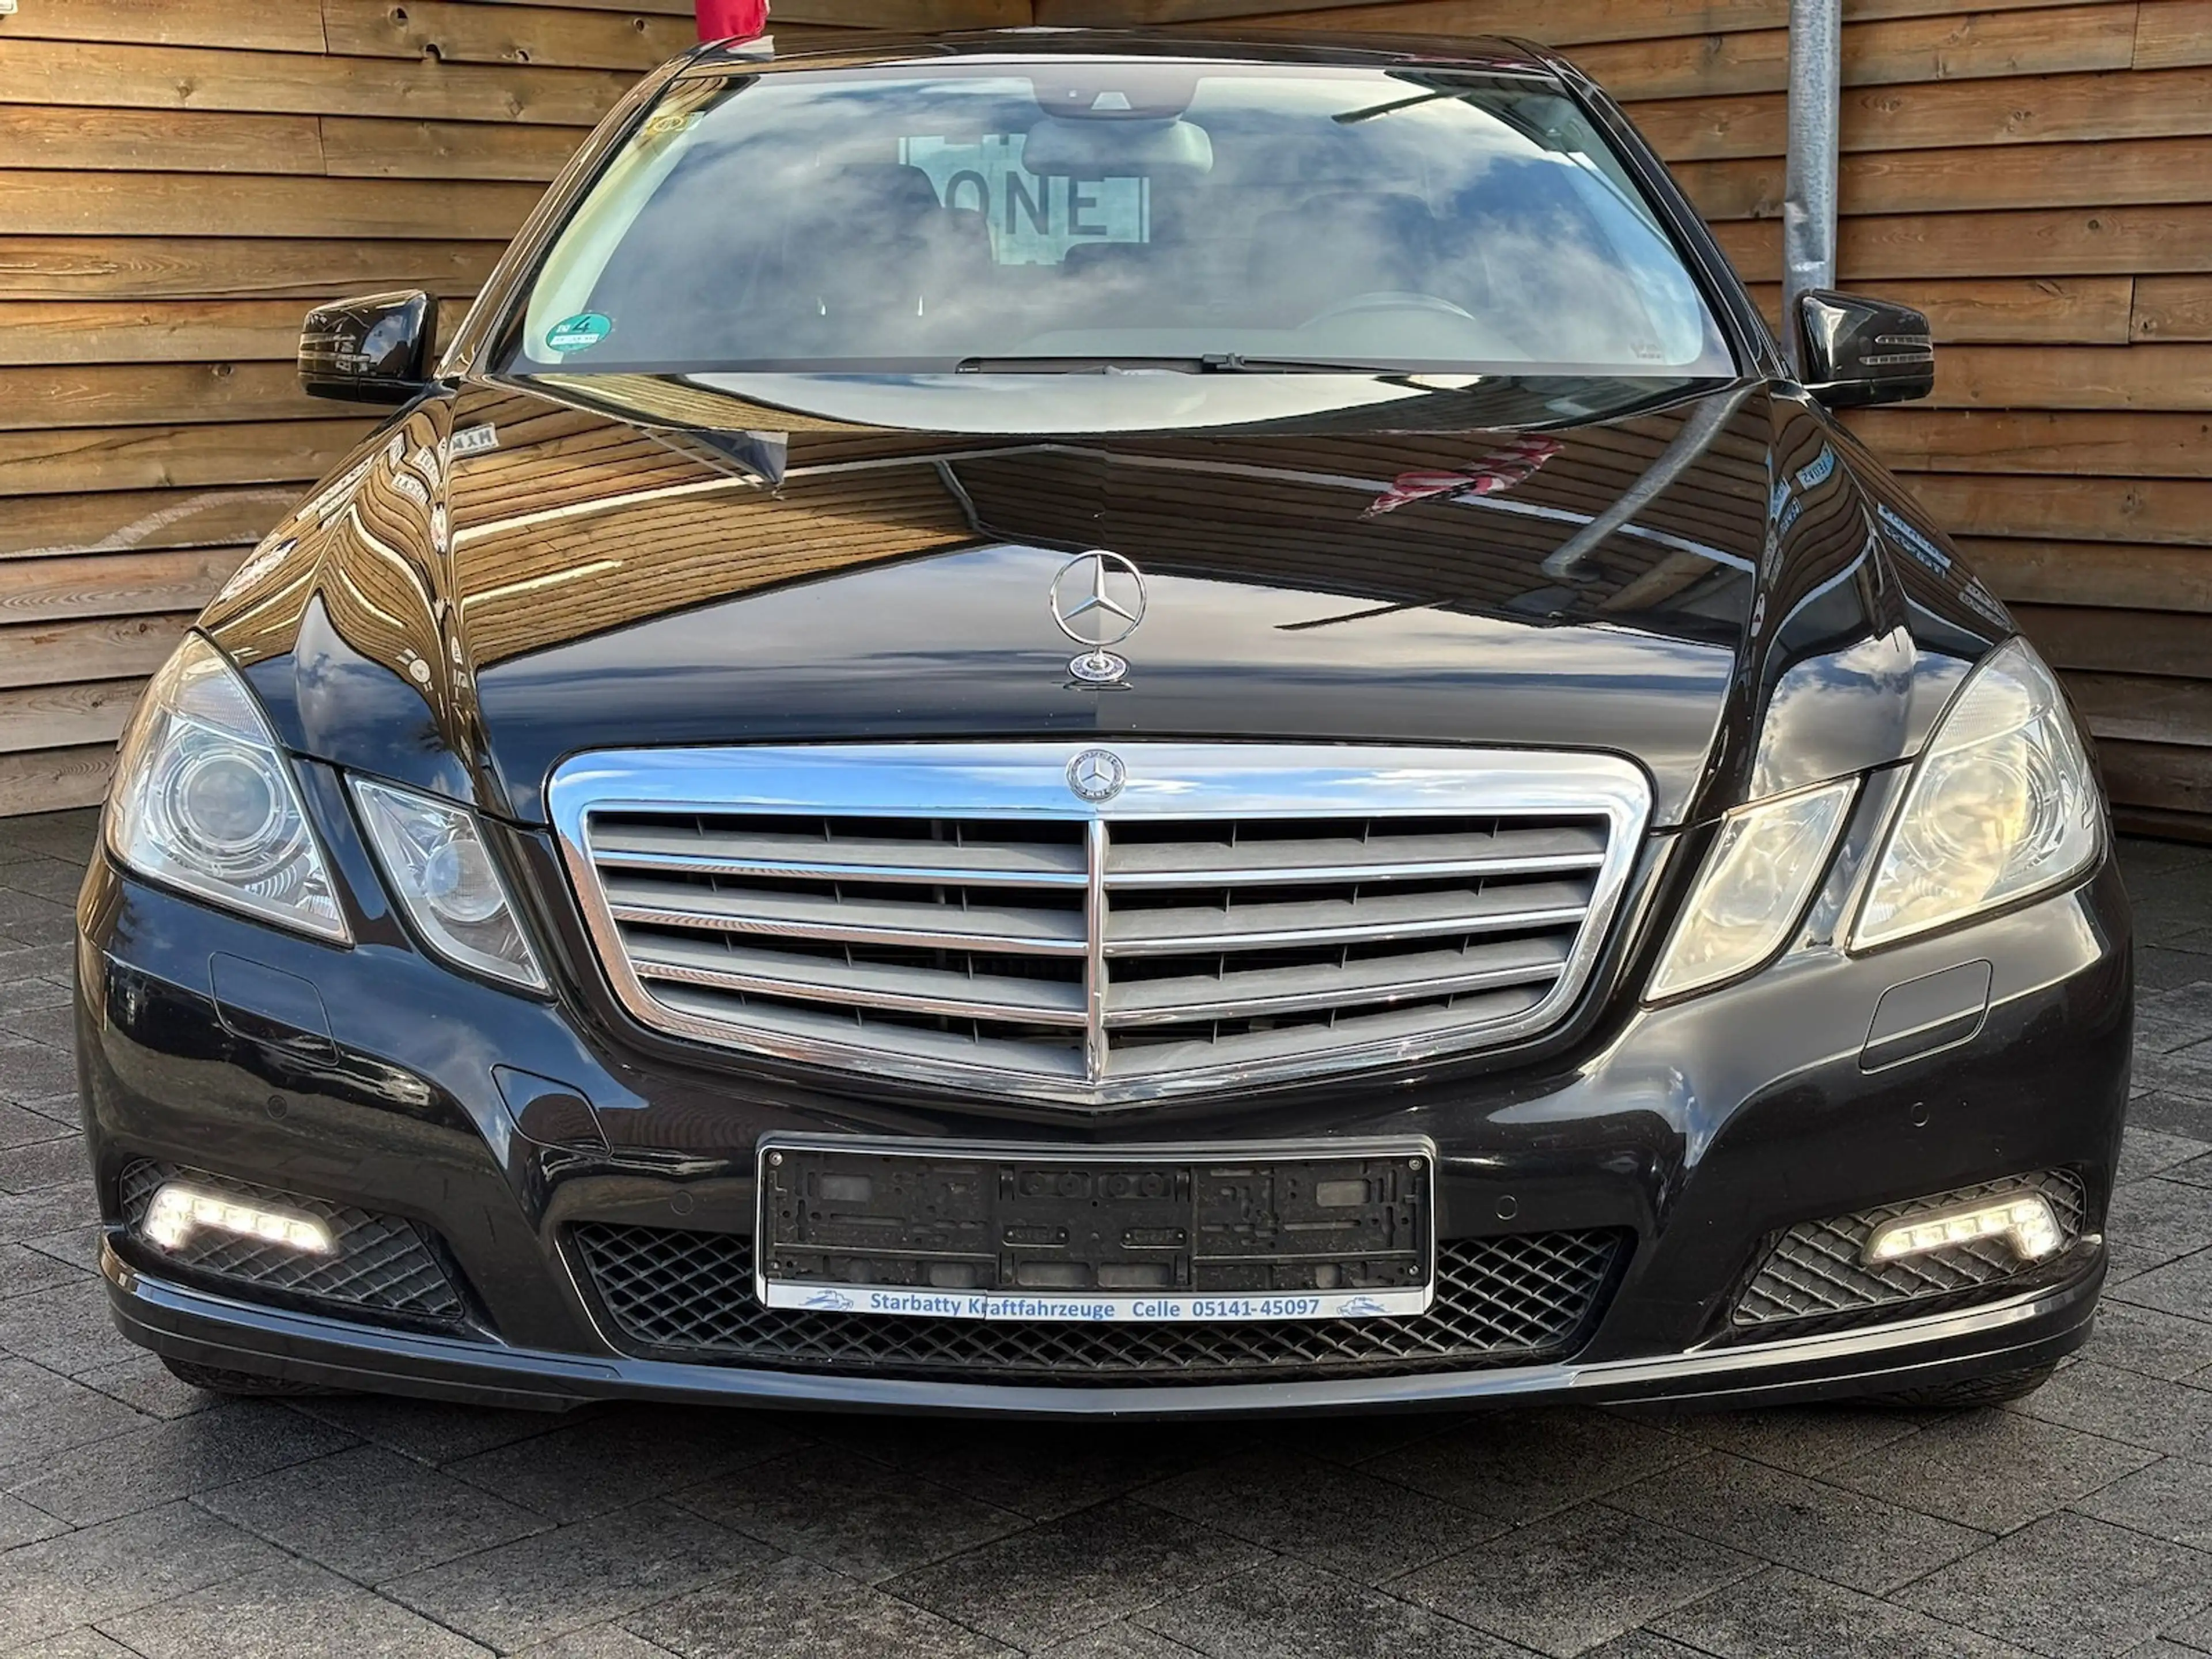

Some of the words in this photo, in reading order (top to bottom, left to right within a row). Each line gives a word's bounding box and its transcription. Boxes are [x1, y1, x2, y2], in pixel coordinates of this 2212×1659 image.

[945, 169, 1107, 235] ONE
[572, 315, 592, 332] 4
[870, 1293, 961, 1316] Starbatty
[968, 1298, 1115, 1320] Kraftfahrzeuge
[1132, 1301, 1181, 1317] Celle
[1192, 1299, 1320, 1317] 05141-45097
